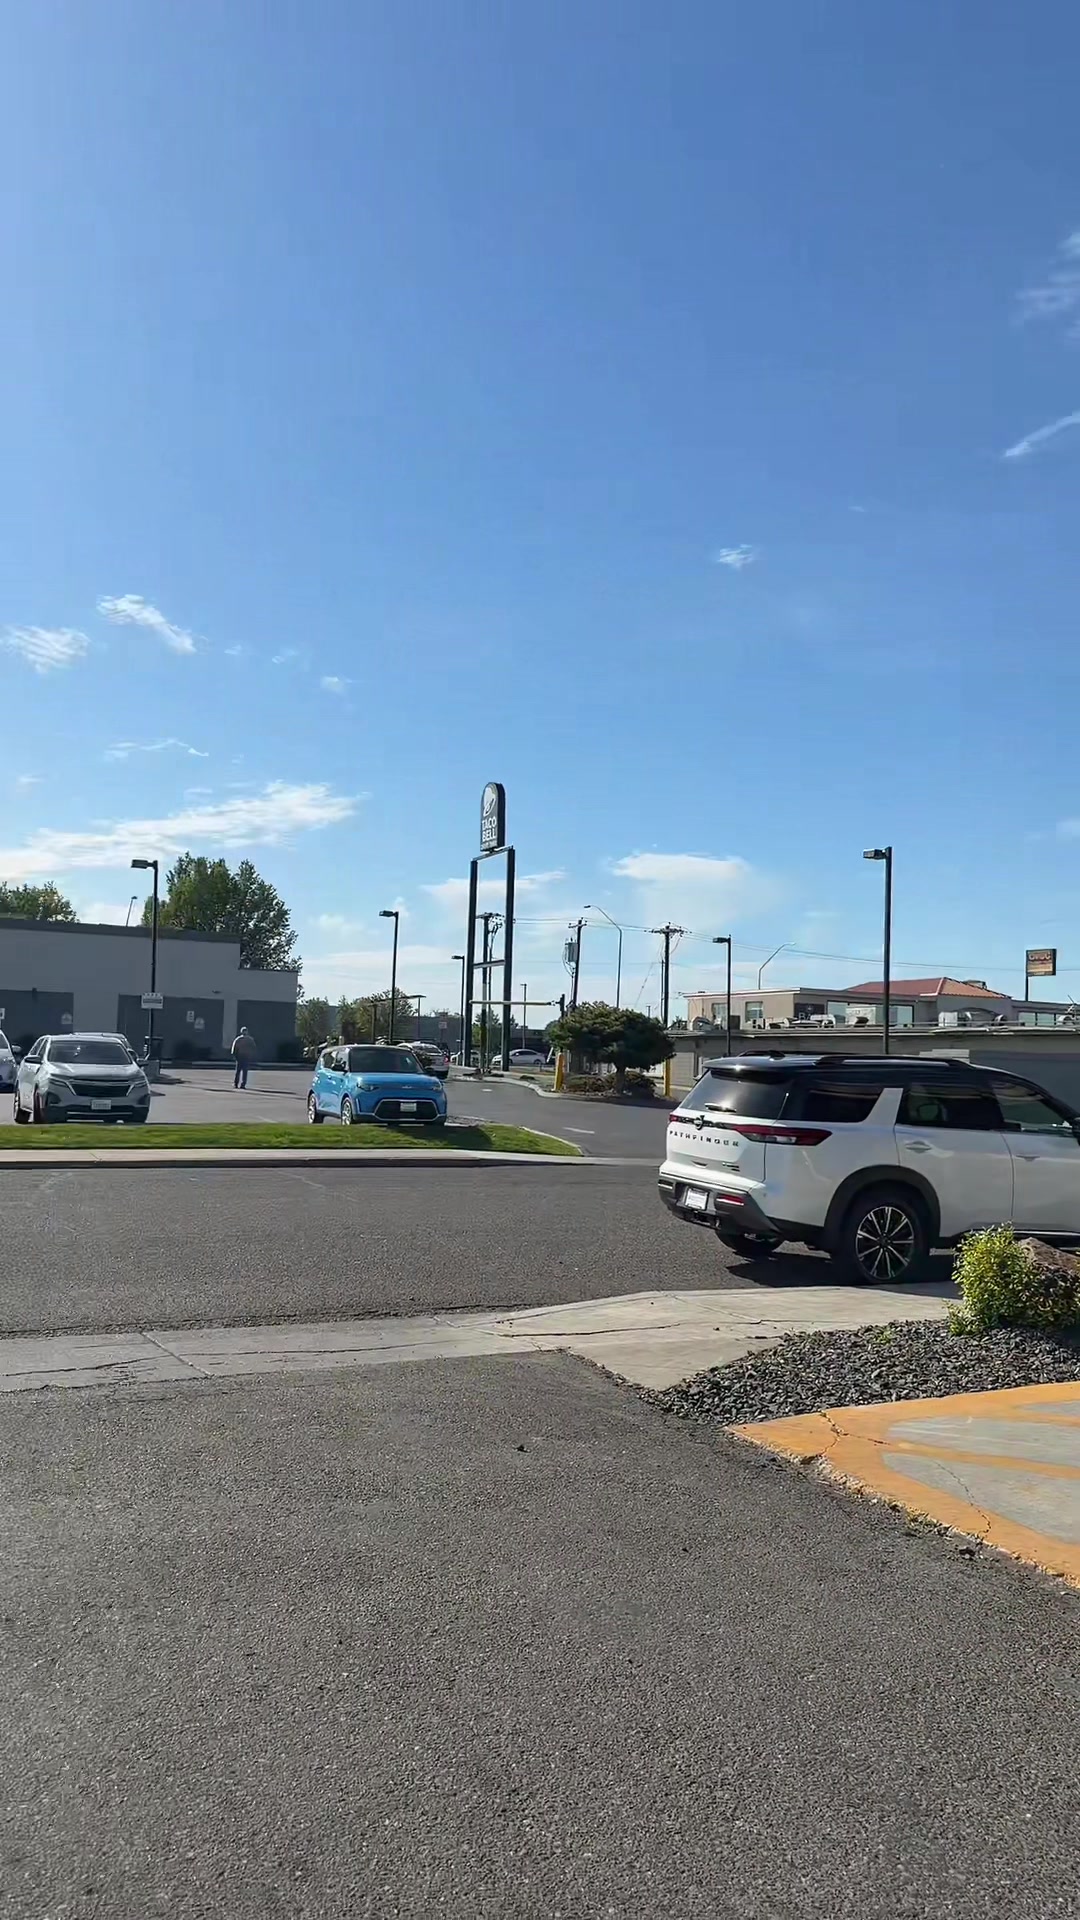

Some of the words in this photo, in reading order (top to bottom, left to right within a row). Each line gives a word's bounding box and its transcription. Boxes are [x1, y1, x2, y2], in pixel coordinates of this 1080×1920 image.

[482, 816, 497, 831] TACO
[482, 828, 497, 842] BELL
[670, 1131, 739, 1147] PATHFINDER
